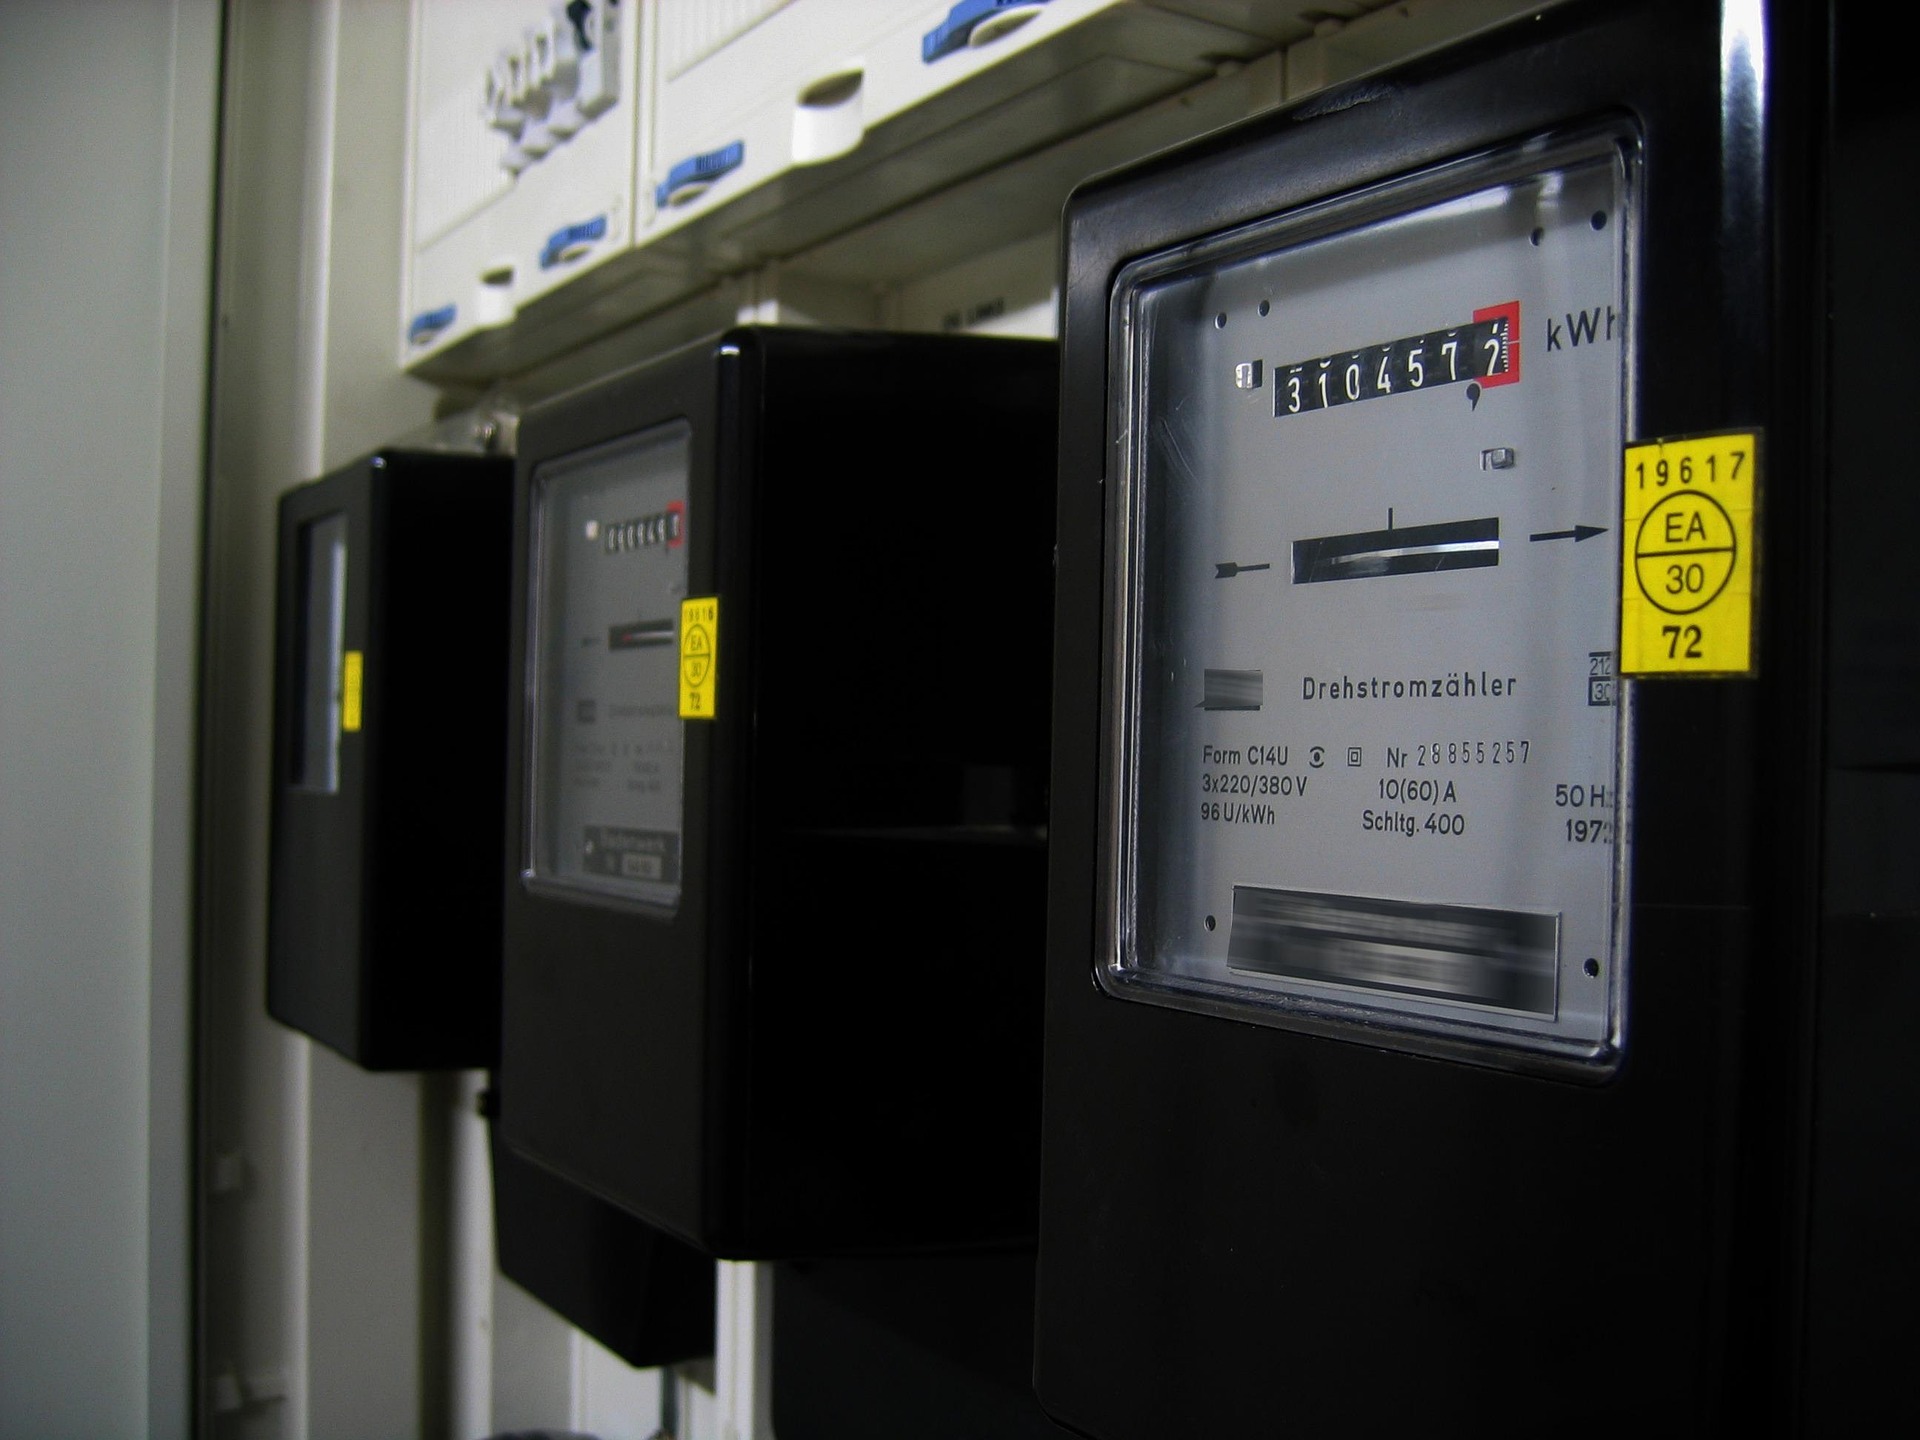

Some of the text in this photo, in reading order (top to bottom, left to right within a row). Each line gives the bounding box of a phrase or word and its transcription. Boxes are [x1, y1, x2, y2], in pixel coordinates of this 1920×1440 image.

[1636, 451, 1745, 490] 19617
[1665, 511, 1706, 543] EA
[1665, 564, 1705, 594] 30
[1662, 625, 1703, 659] 72
[1303, 672, 1516, 700] Drehstromzähler
[1203, 745, 1289, 766] Form C14U
[1387, 741, 1530, 768] Nr 28855257
[1202, 774, 1307, 796] 3x220/380 V
[1379, 778, 1457, 803] 10(60) A
[1556, 785, 1616, 807] 50 H
[1201, 802, 1276, 825] 96 U/kWh
[1363, 810, 1465, 836] Schltg. 400
